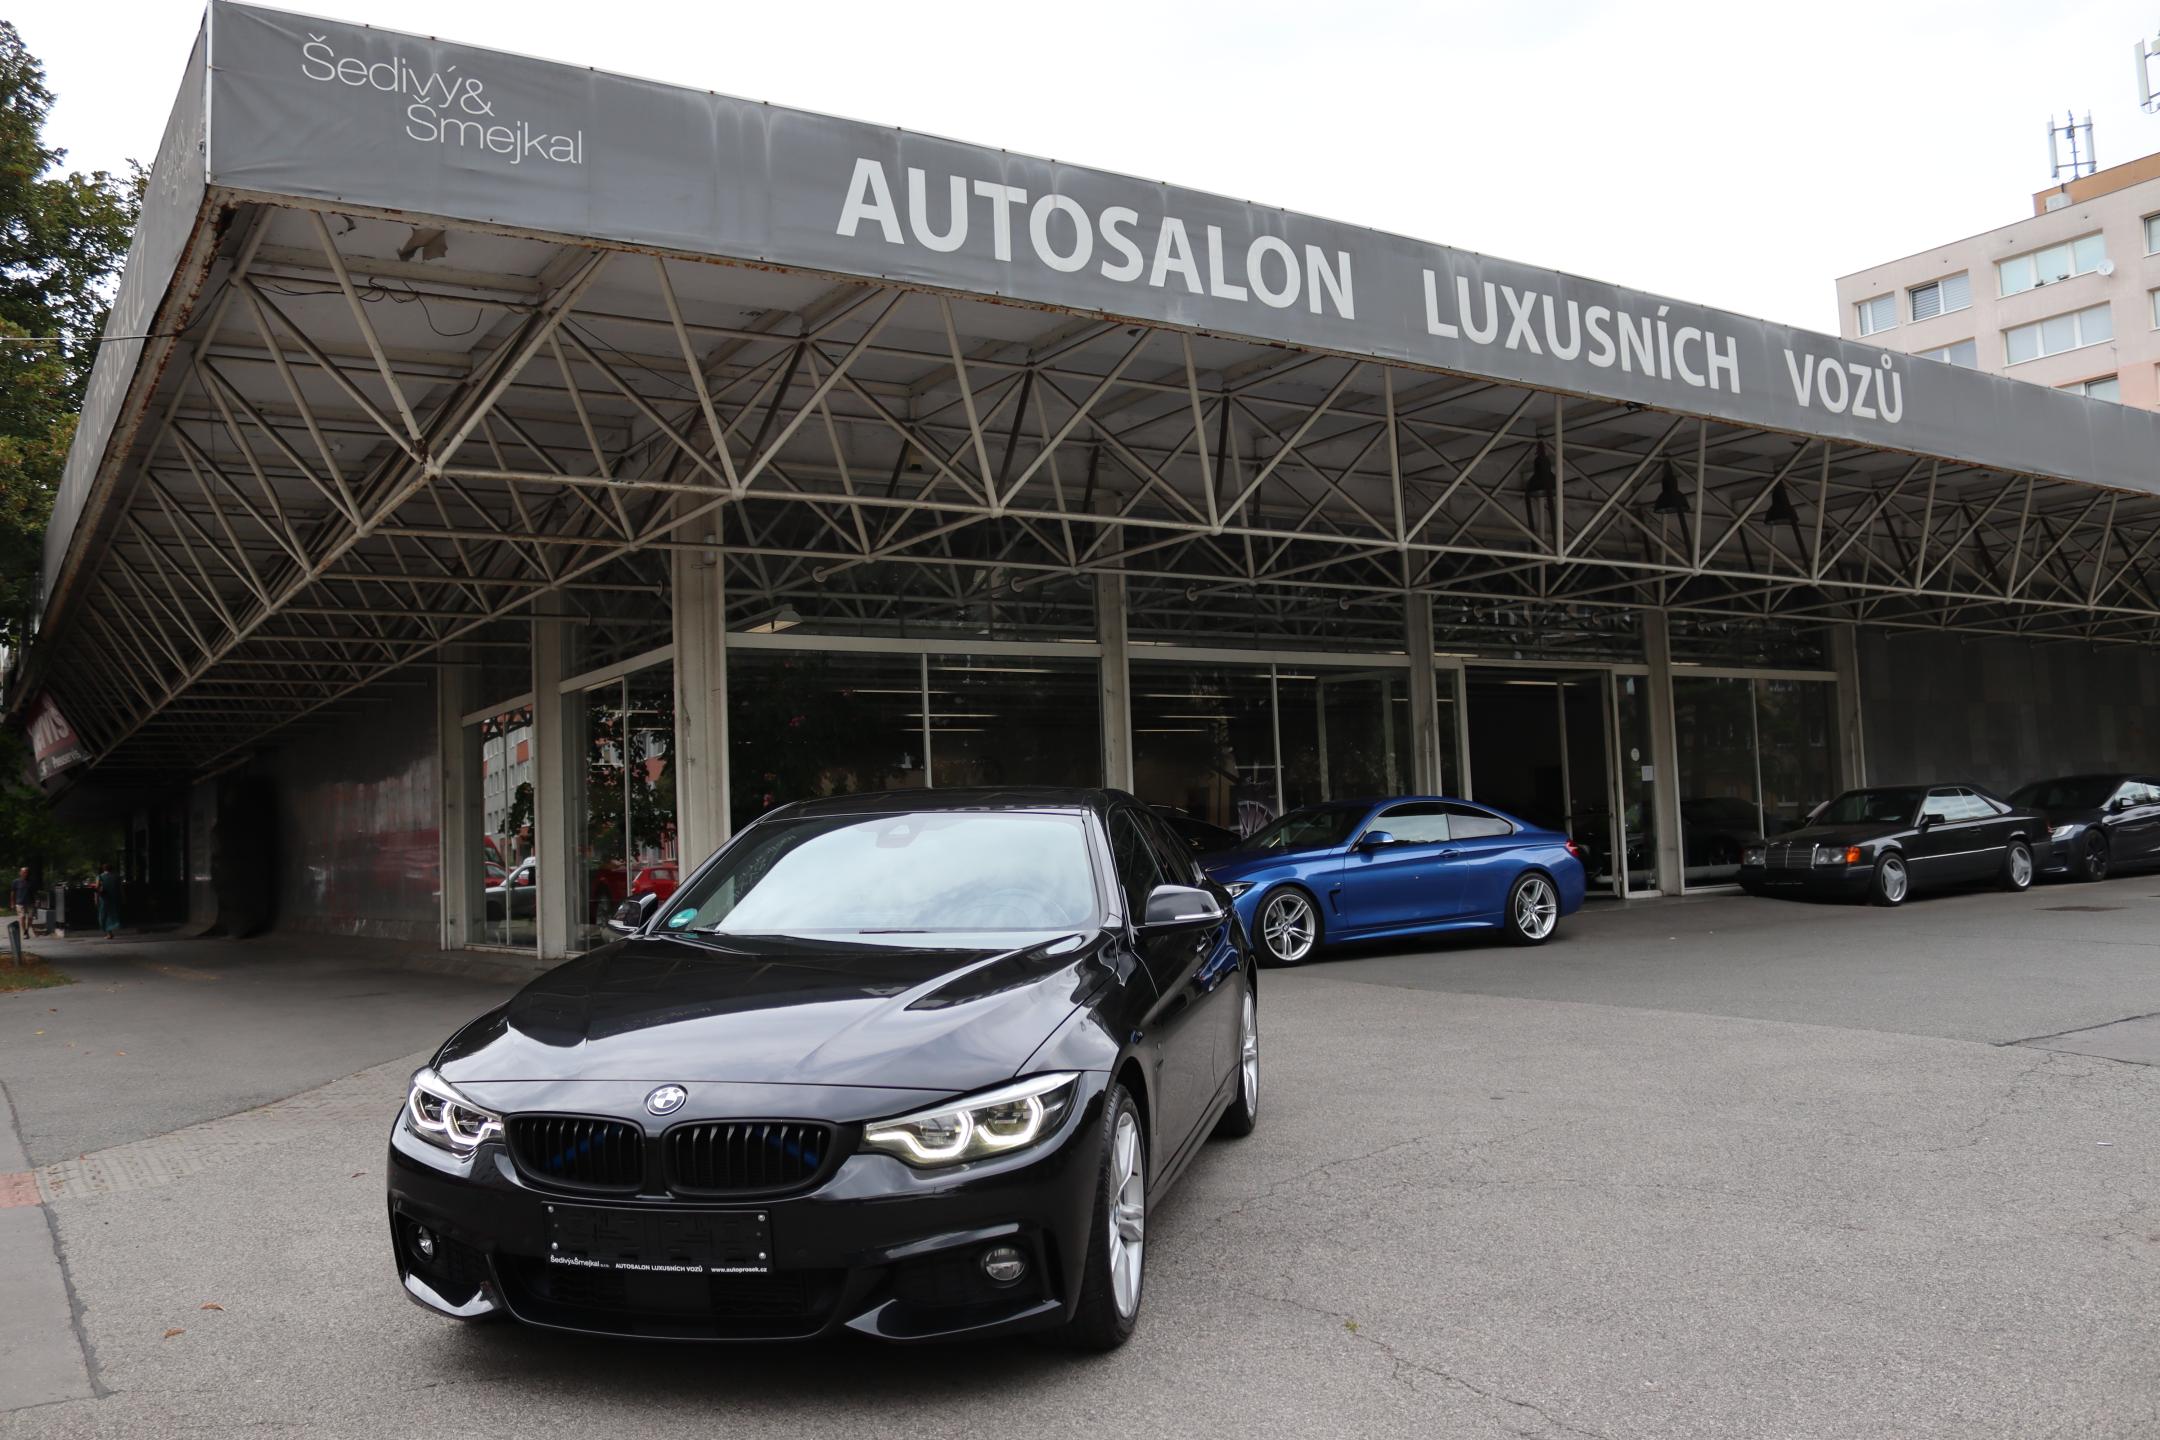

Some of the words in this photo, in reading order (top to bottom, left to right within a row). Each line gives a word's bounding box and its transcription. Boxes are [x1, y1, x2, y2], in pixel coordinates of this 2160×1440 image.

[301, 33, 495, 117] Šedivý&
[406, 94, 583, 165] Šmejkal
[836, 157, 1356, 321] AUTOSALON
[1422, 268, 1742, 395] LUXUSNÍCH
[1783, 348, 1904, 425] VOZŮ
[615, 1262, 650, 1271] AUTOSALON
[651, 1264, 686, 1272] LUXUSNÍCH
[686, 1264, 703, 1273] VOZŮ
